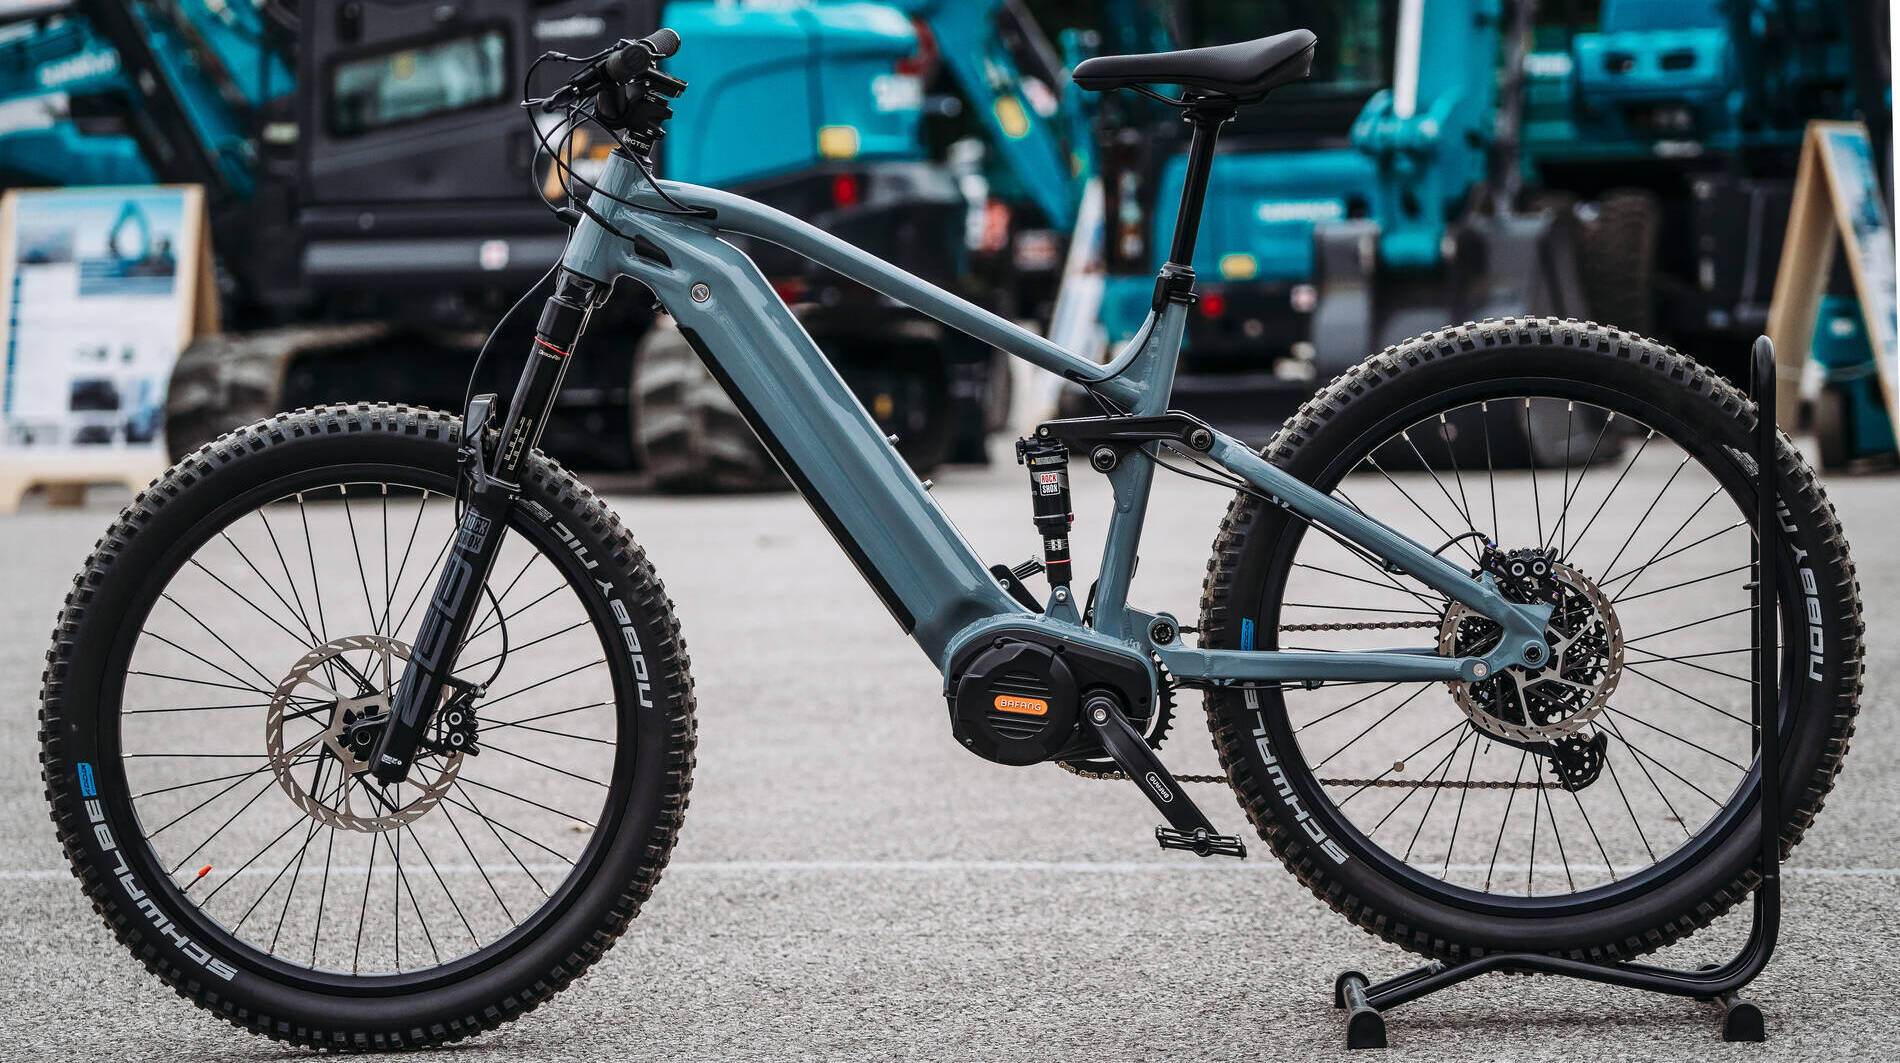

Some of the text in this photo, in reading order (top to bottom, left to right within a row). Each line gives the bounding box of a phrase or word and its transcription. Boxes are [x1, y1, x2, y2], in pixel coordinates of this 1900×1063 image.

[1041, 474, 1057, 483] ROCK
[1042, 484, 1058, 494] SHOX
[551, 521, 653, 708] NOBBY NIC
[1791, 543, 1824, 682] NOBBY
[1000, 699, 1042, 711] BAFANG
[1150, 775, 1169, 799] BAFANG
[1243, 682, 1350, 865] SCHWALB
[84, 799, 238, 981] SCHWALBE
